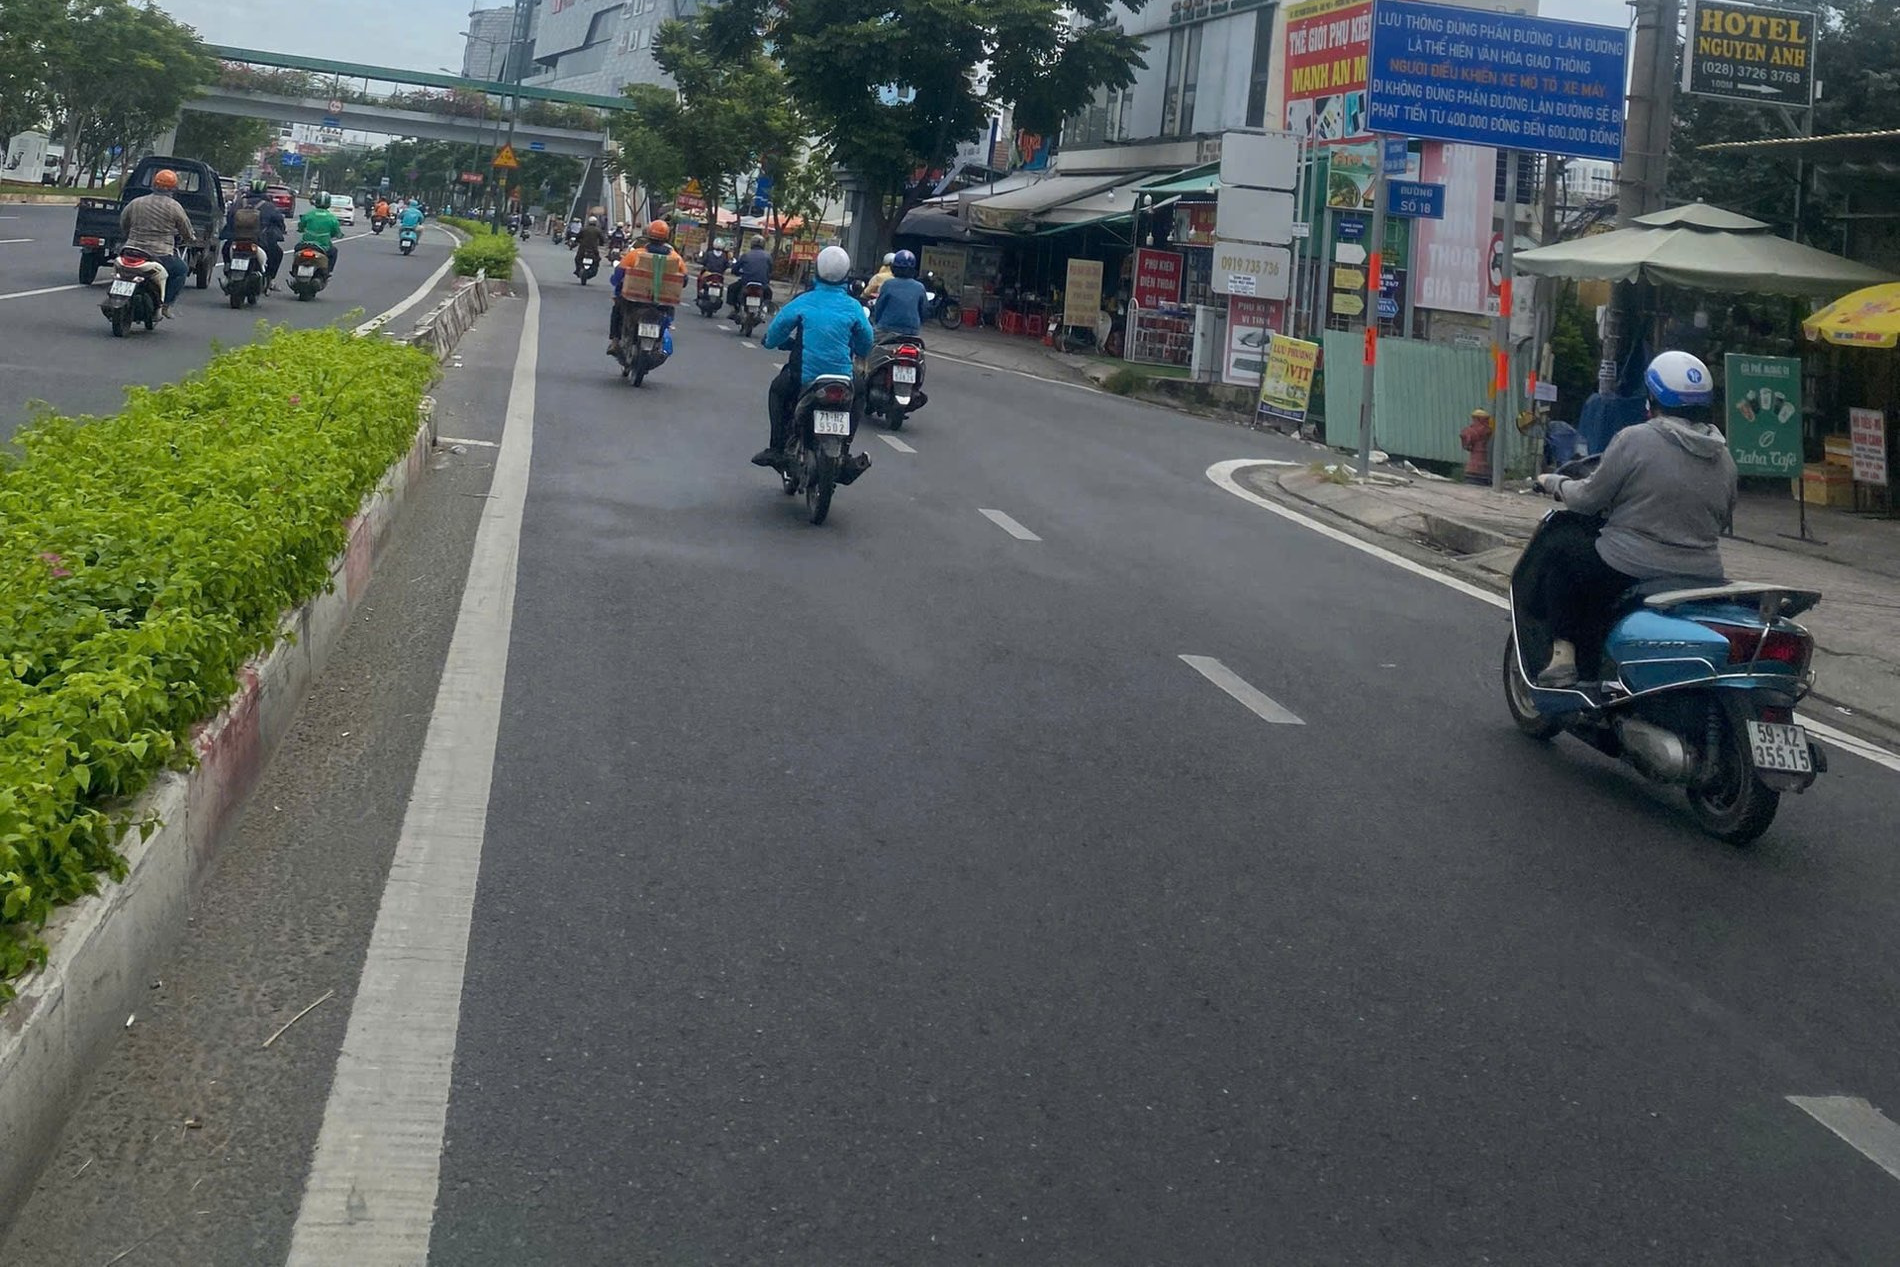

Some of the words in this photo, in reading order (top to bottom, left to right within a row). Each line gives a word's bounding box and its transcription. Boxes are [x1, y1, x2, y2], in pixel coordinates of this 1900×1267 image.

[1406, 13, 1443, 32] THÔNG
[1701, 9, 1807, 44] HOTEL
[1290, 20, 1308, 56] THẾ
[1308, 21, 1328, 53] GIỚI
[1329, 19, 1350, 50] PHỤ
[1408, 34, 1423, 53] LÀ
[1525, 52, 1551, 70] GIAO
[1555, 56, 1591, 74] THÔNG
[1699, 37, 1767, 62] NGUYEN
[1770, 46, 1806, 67] ANH
[1292, 63, 1329, 95] MẠNH
[1332, 59, 1351, 87] AN
[1501, 71, 1517, 87] XE
[1563, 79, 1580, 95] XE
[1702, 61, 1734, 77] (028)
[1737, 65, 1767, 80] 3726
[1770, 70, 1801, 84] 3768
[1372, 79, 1384, 93] ĐI
[1385, 79, 1423, 99] KHÔNG
[1371, 102, 1400, 122] PHẠT
[1447, 111, 1488, 129] 400.000
[1548, 124, 1587, 142] 600.000
[1420, 202, 1432, 214] 18
[1755, 745, 1809, 769] 355.15
